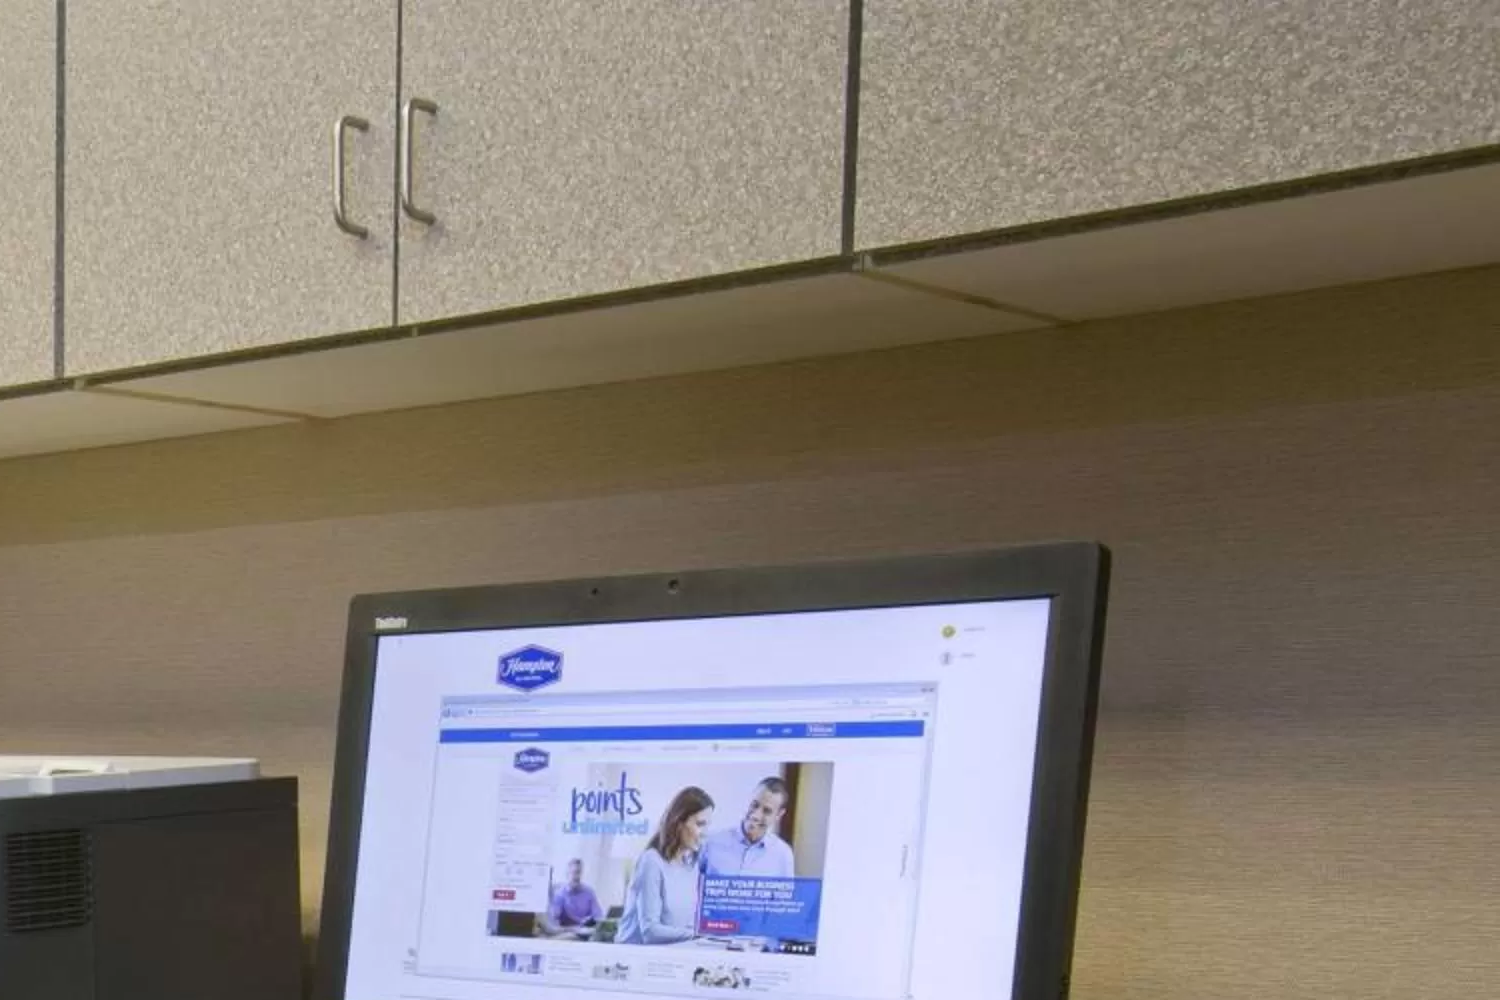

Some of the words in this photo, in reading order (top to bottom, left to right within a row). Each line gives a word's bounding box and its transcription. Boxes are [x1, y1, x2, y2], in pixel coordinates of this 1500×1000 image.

[571, 770, 643, 822] points
[562, 818, 649, 836] unlimited
[731, 879, 754, 889] YOUR
[755, 889, 773, 899] FOR
[774, 890, 793, 900] YOU
